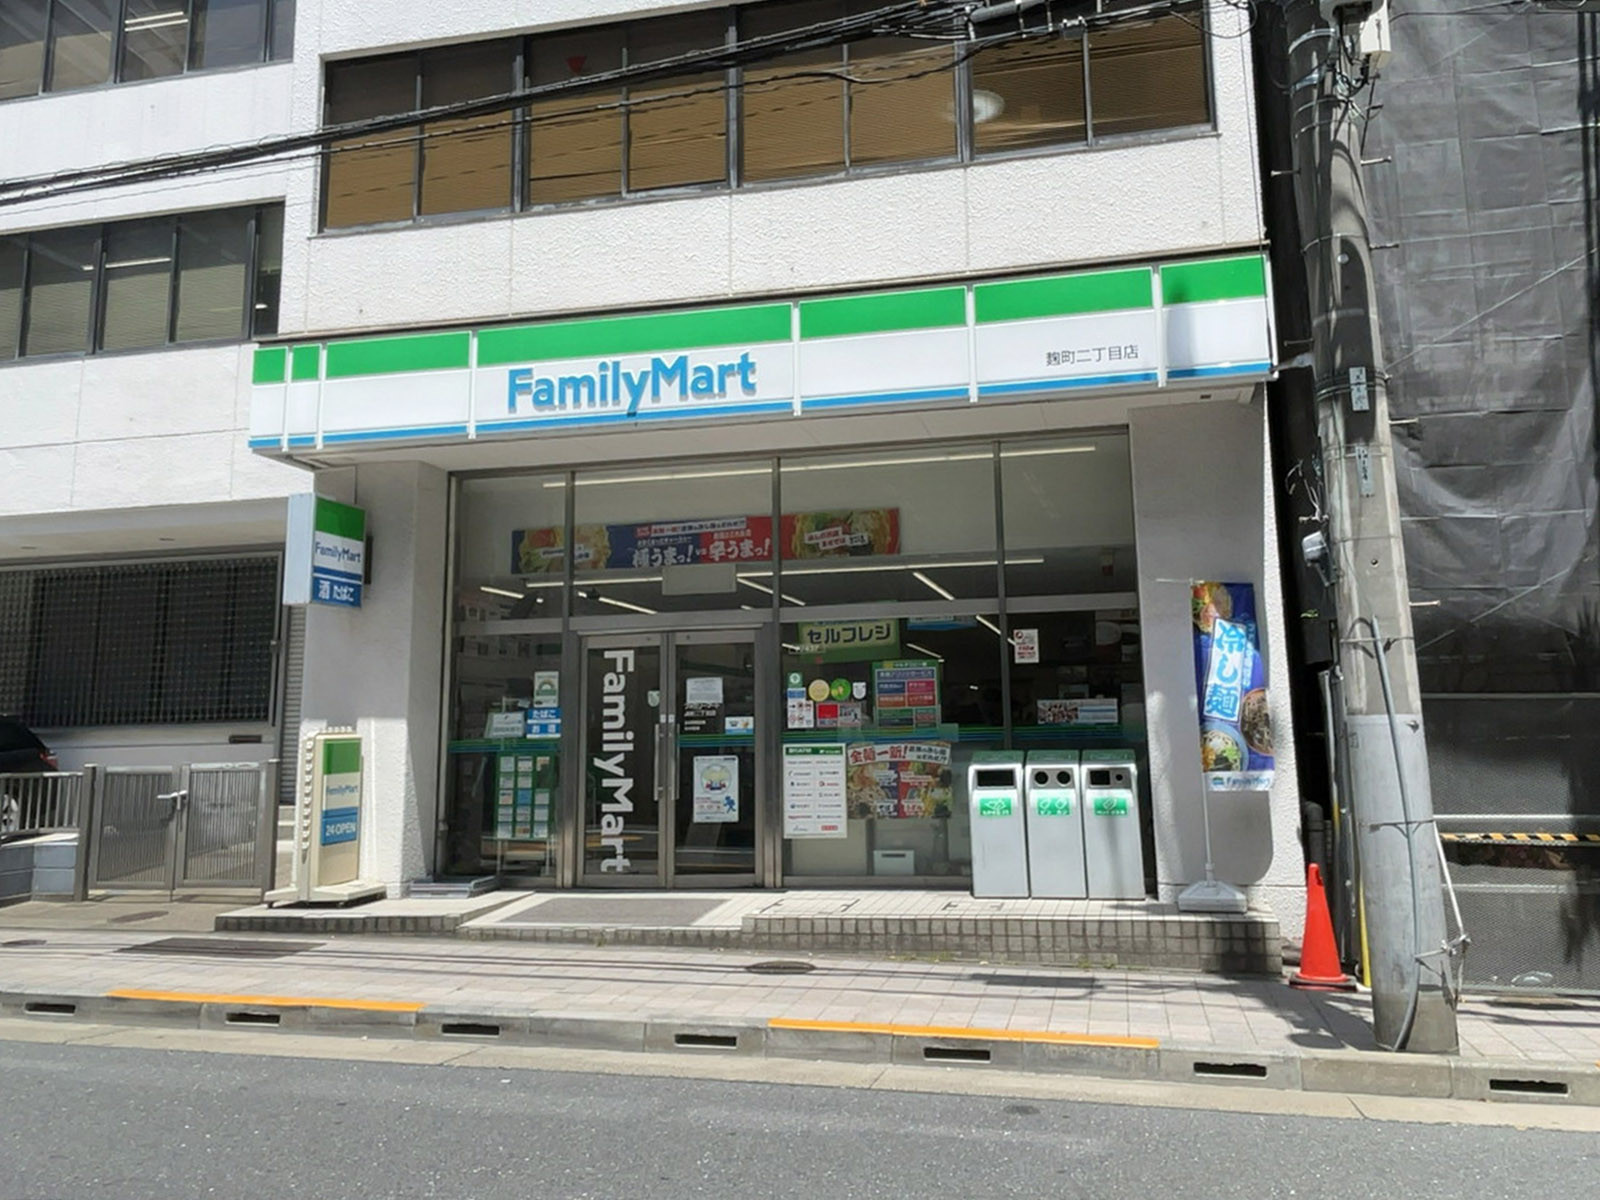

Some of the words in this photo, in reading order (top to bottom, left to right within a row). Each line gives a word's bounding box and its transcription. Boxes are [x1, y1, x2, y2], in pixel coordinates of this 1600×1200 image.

[508, 352, 756, 415] FamilyMart
[315, 542, 361, 562] FamilyMart
[807, 623, 891, 645] セルフレジ
[1206, 622, 1245, 718] 冷し麺
[594, 650, 635, 872] FamilyMart
